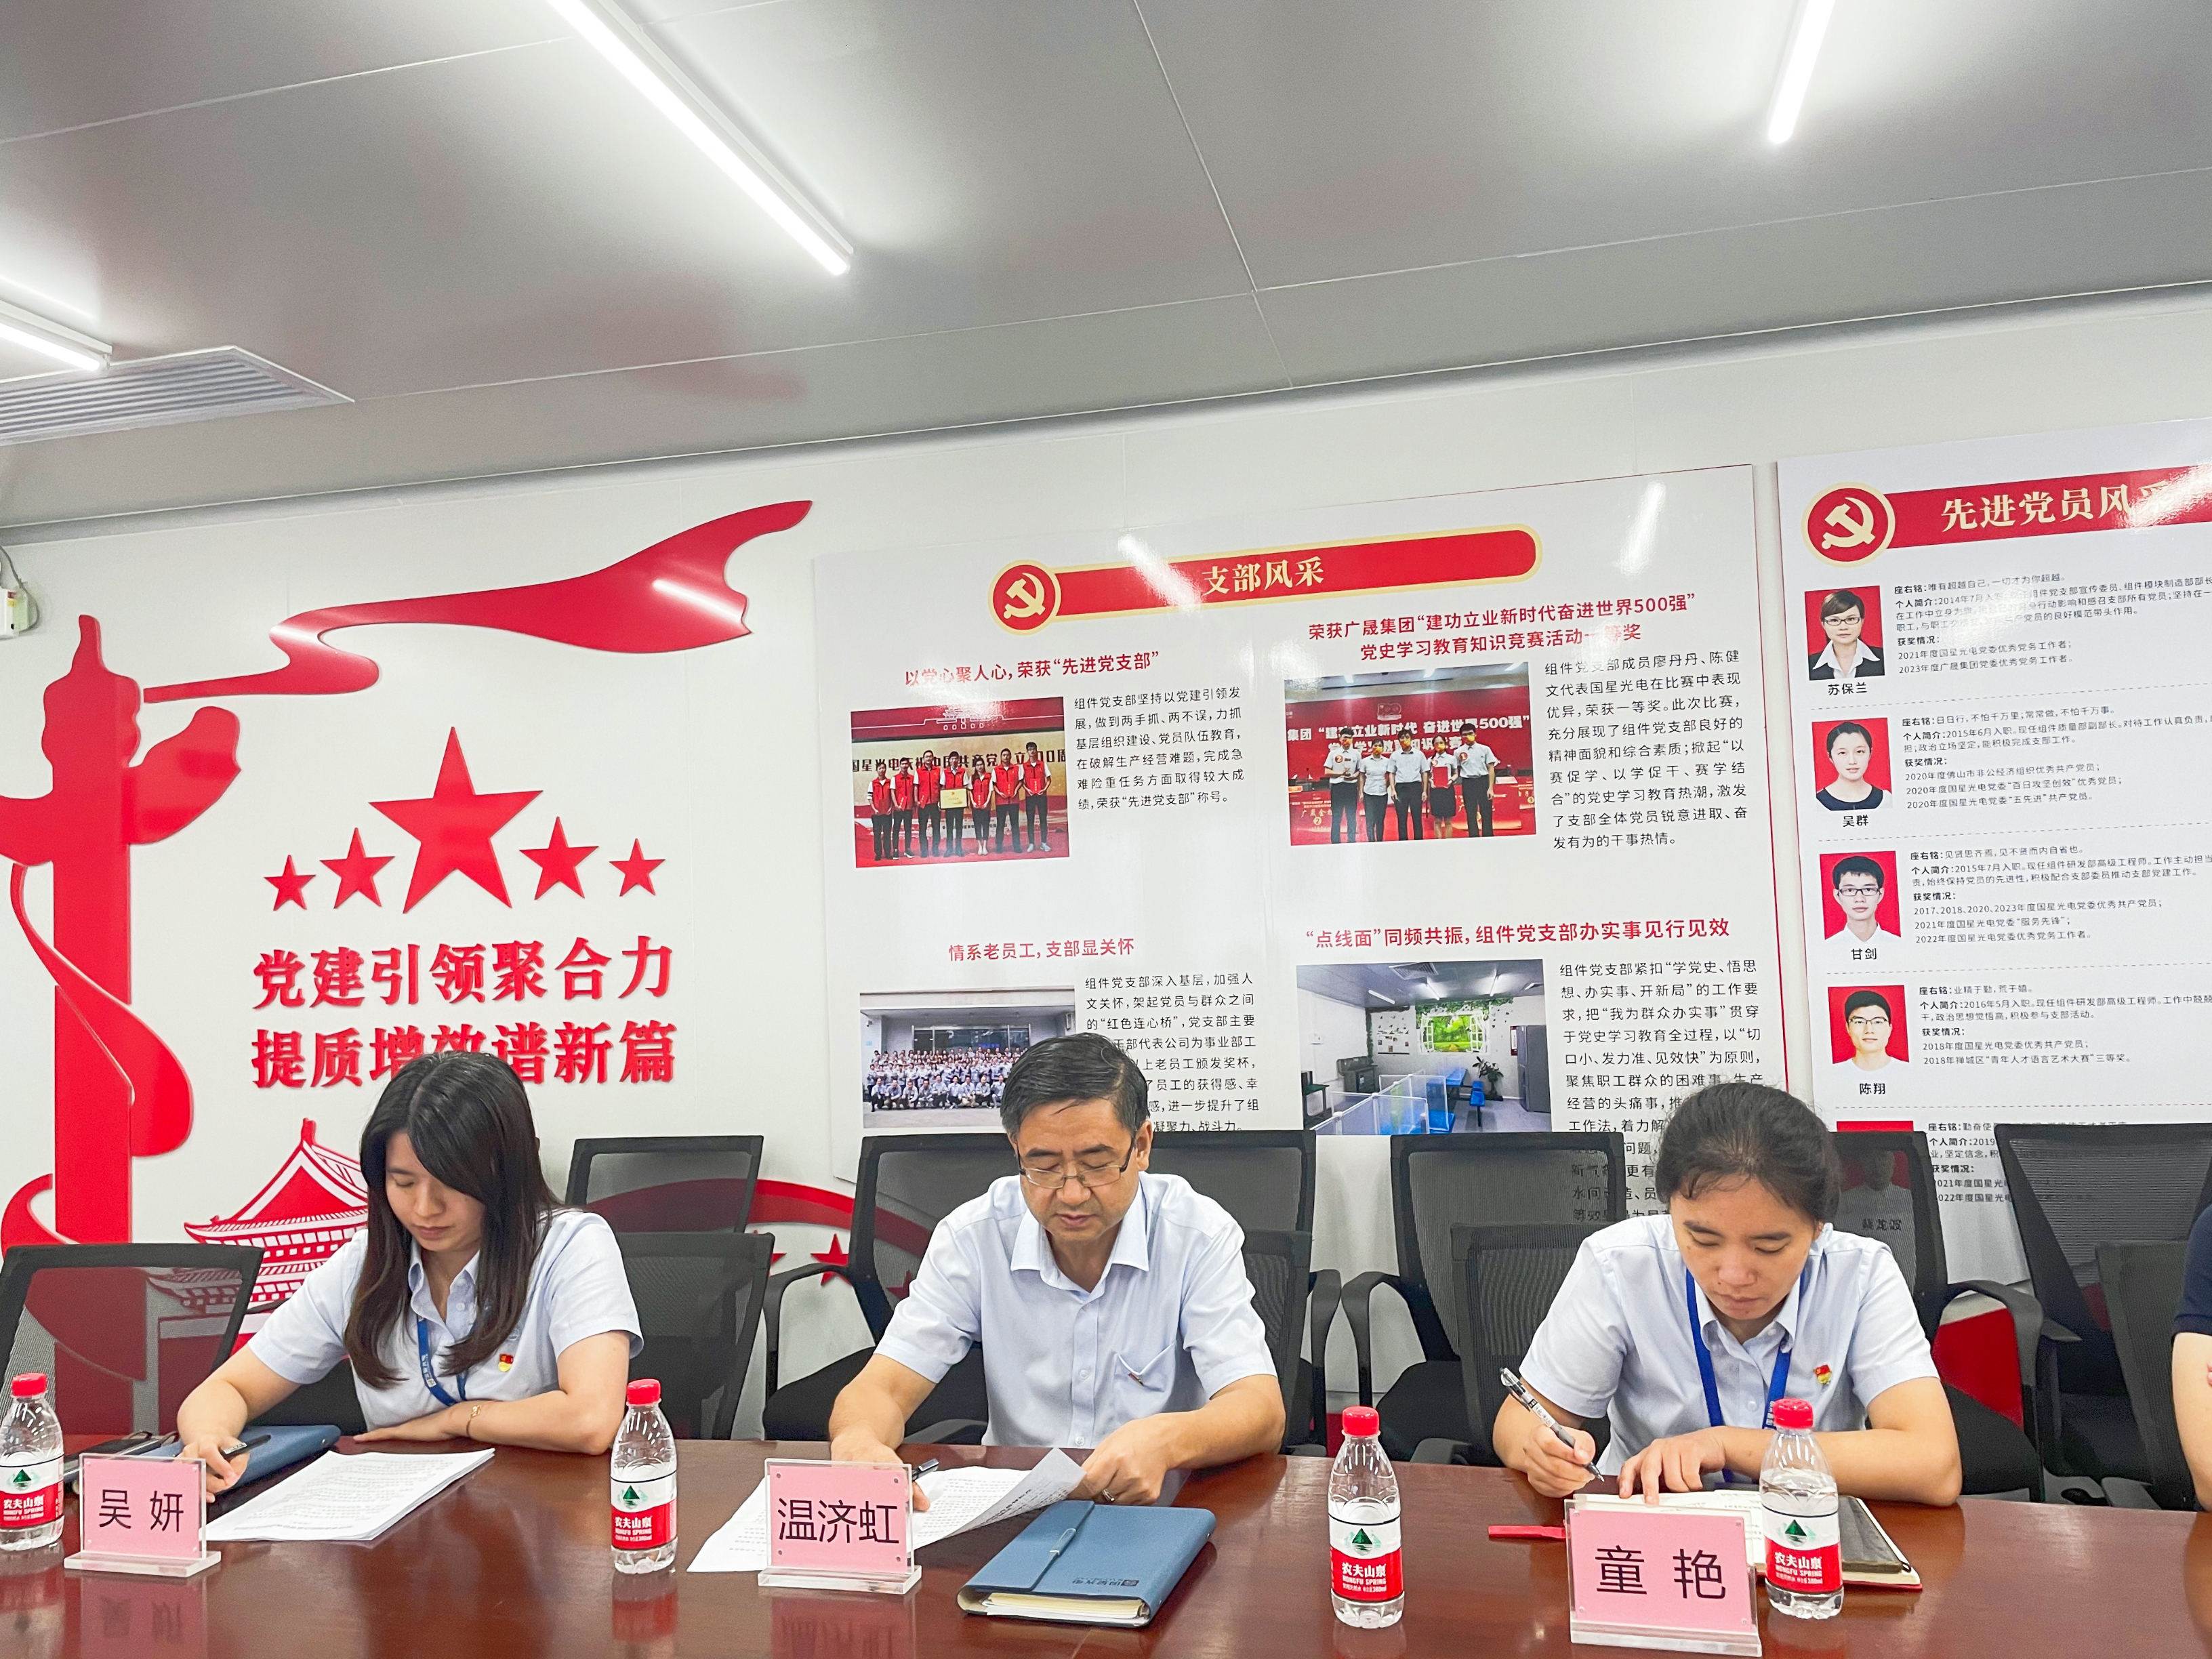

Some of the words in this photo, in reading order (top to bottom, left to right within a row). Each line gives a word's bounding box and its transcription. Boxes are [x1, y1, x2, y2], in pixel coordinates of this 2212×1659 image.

[1202, 556, 1325, 597] 支部风采
[1308, 593, 1696, 641] 荣获广晟集团“建功立业新时代奋进世界500强”
[1360, 623, 1641, 661] 党史学习教育知识竞赛活动一等奖
[1898, 636, 1940, 647] 获奖情况：
[904, 651, 1160, 687] 以党心聚人心，荣获“先进党支部”
[1544, 650, 1740, 676] 组件党支部成员廖丹丹、陈健
[1545, 672, 1741, 698] 文代表国星光电在比赛中表现
[1828, 682, 1868, 695] 苏保兰
[1074, 687, 1241, 710] 组件党支部坚持以党建引领发
[1547, 695, 1740, 719] 优异，荣获一等奖。此次比赛，
[1075, 707, 1242, 730] 展，做到两手抓、两不误，力抓
[1548, 716, 1743, 741] 充分展现了组件党支部良好的
[1076, 728, 1241, 750] 基层组织建设、党员队伍教育，
[1077, 748, 1244, 771] 在破解生产经营难题，完成急
[1549, 739, 1744, 762] 精神面貌和综合素质；掀起“以
[1550, 761, 1745, 785] 赛促学、以学促干、赛学结
[1904, 757, 1947, 768] 获奖情况：
[1077, 769, 1244, 790] 难险重任务方面取得较大成
[1078, 790, 1228, 811] 绩，荣获“先进党支部”称号。
[1551, 783, 1747, 806] 合”的党史学习教育热潮，激发
[1553, 806, 1748, 828] 了支部全体党员锐意进取、奋
[1843, 815, 1869, 827] 吴群
[1554, 832, 1676, 850] 发有为的干事热情。
[1913, 892, 1956, 901] 获奖情况：
[1306, 918, 1730, 948] “点线面”同频共振，组件党支部办实事见行见效
[948, 937, 1134, 962] 情系老员工，支部显关怀
[1851, 948, 1877, 960] 甘剑
[252, 935, 673, 1010] 党建引领聚合力
[1559, 960, 1757, 977] 组件党支部紧扣“学党史、悟思
[1085, 972, 1253, 989] 组件党支部深入基层，加强人
[1561, 982, 1758, 999] 想、办实事、开新局”的工作要
[1086, 994, 1254, 1010] 文关怀，架起党员与群众之间
[1087, 1015, 1256, 1031] 的“红色连心桥”，党支部主要
[1562, 1005, 1759, 1021] 求，把“我为群众办实事”贯穿
[1563, 1027, 1761, 1044] 于党史学习教育全过程，以“切
[1922, 1027, 1965, 1037] 获奖情况：
[1565, 1050, 1761, 1065] 口小、发力准、见效快”为原则，
[1860, 1083, 1886, 1094] 陈翔
[3, 1494, 44, 1509] 农夫山泉
[615, 1516, 652, 1528] 农夫山泉
[777, 1498, 899, 1544] 温济虹
[1342, 1562, 1387, 1578] 农夫山泉
[1774, 1552, 1822, 1570] 农夫山泉
